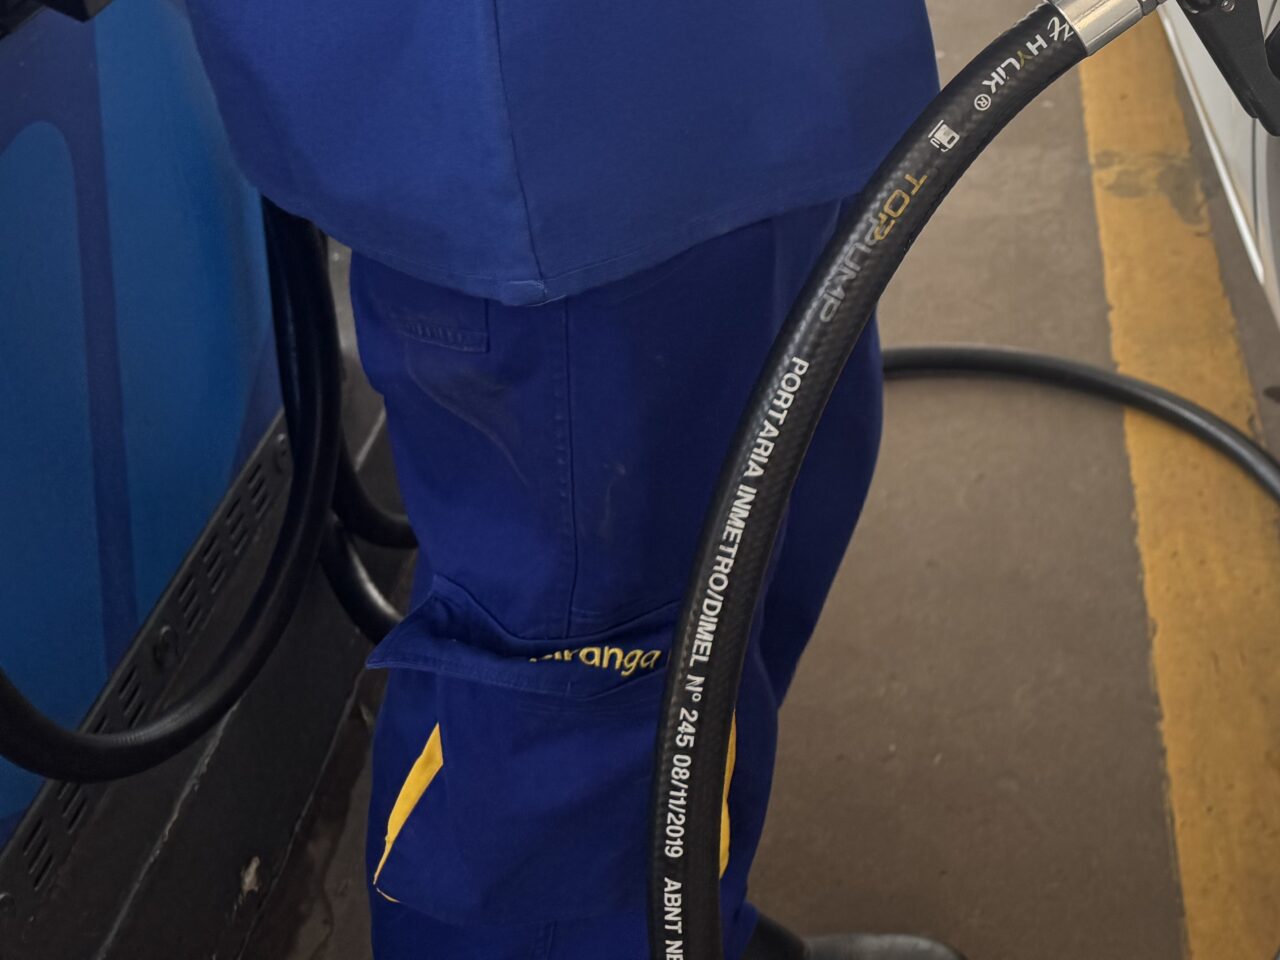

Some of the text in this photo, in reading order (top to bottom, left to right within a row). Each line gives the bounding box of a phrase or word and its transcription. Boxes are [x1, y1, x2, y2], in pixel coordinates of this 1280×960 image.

[743, 355, 810, 478] PORTARIA
[689, 485, 758, 669] INMETRO/DIMEL
[675, 707, 699, 748] 245
[664, 754, 692, 859] 08/11/2019
[663, 877, 682, 935] ABNT
